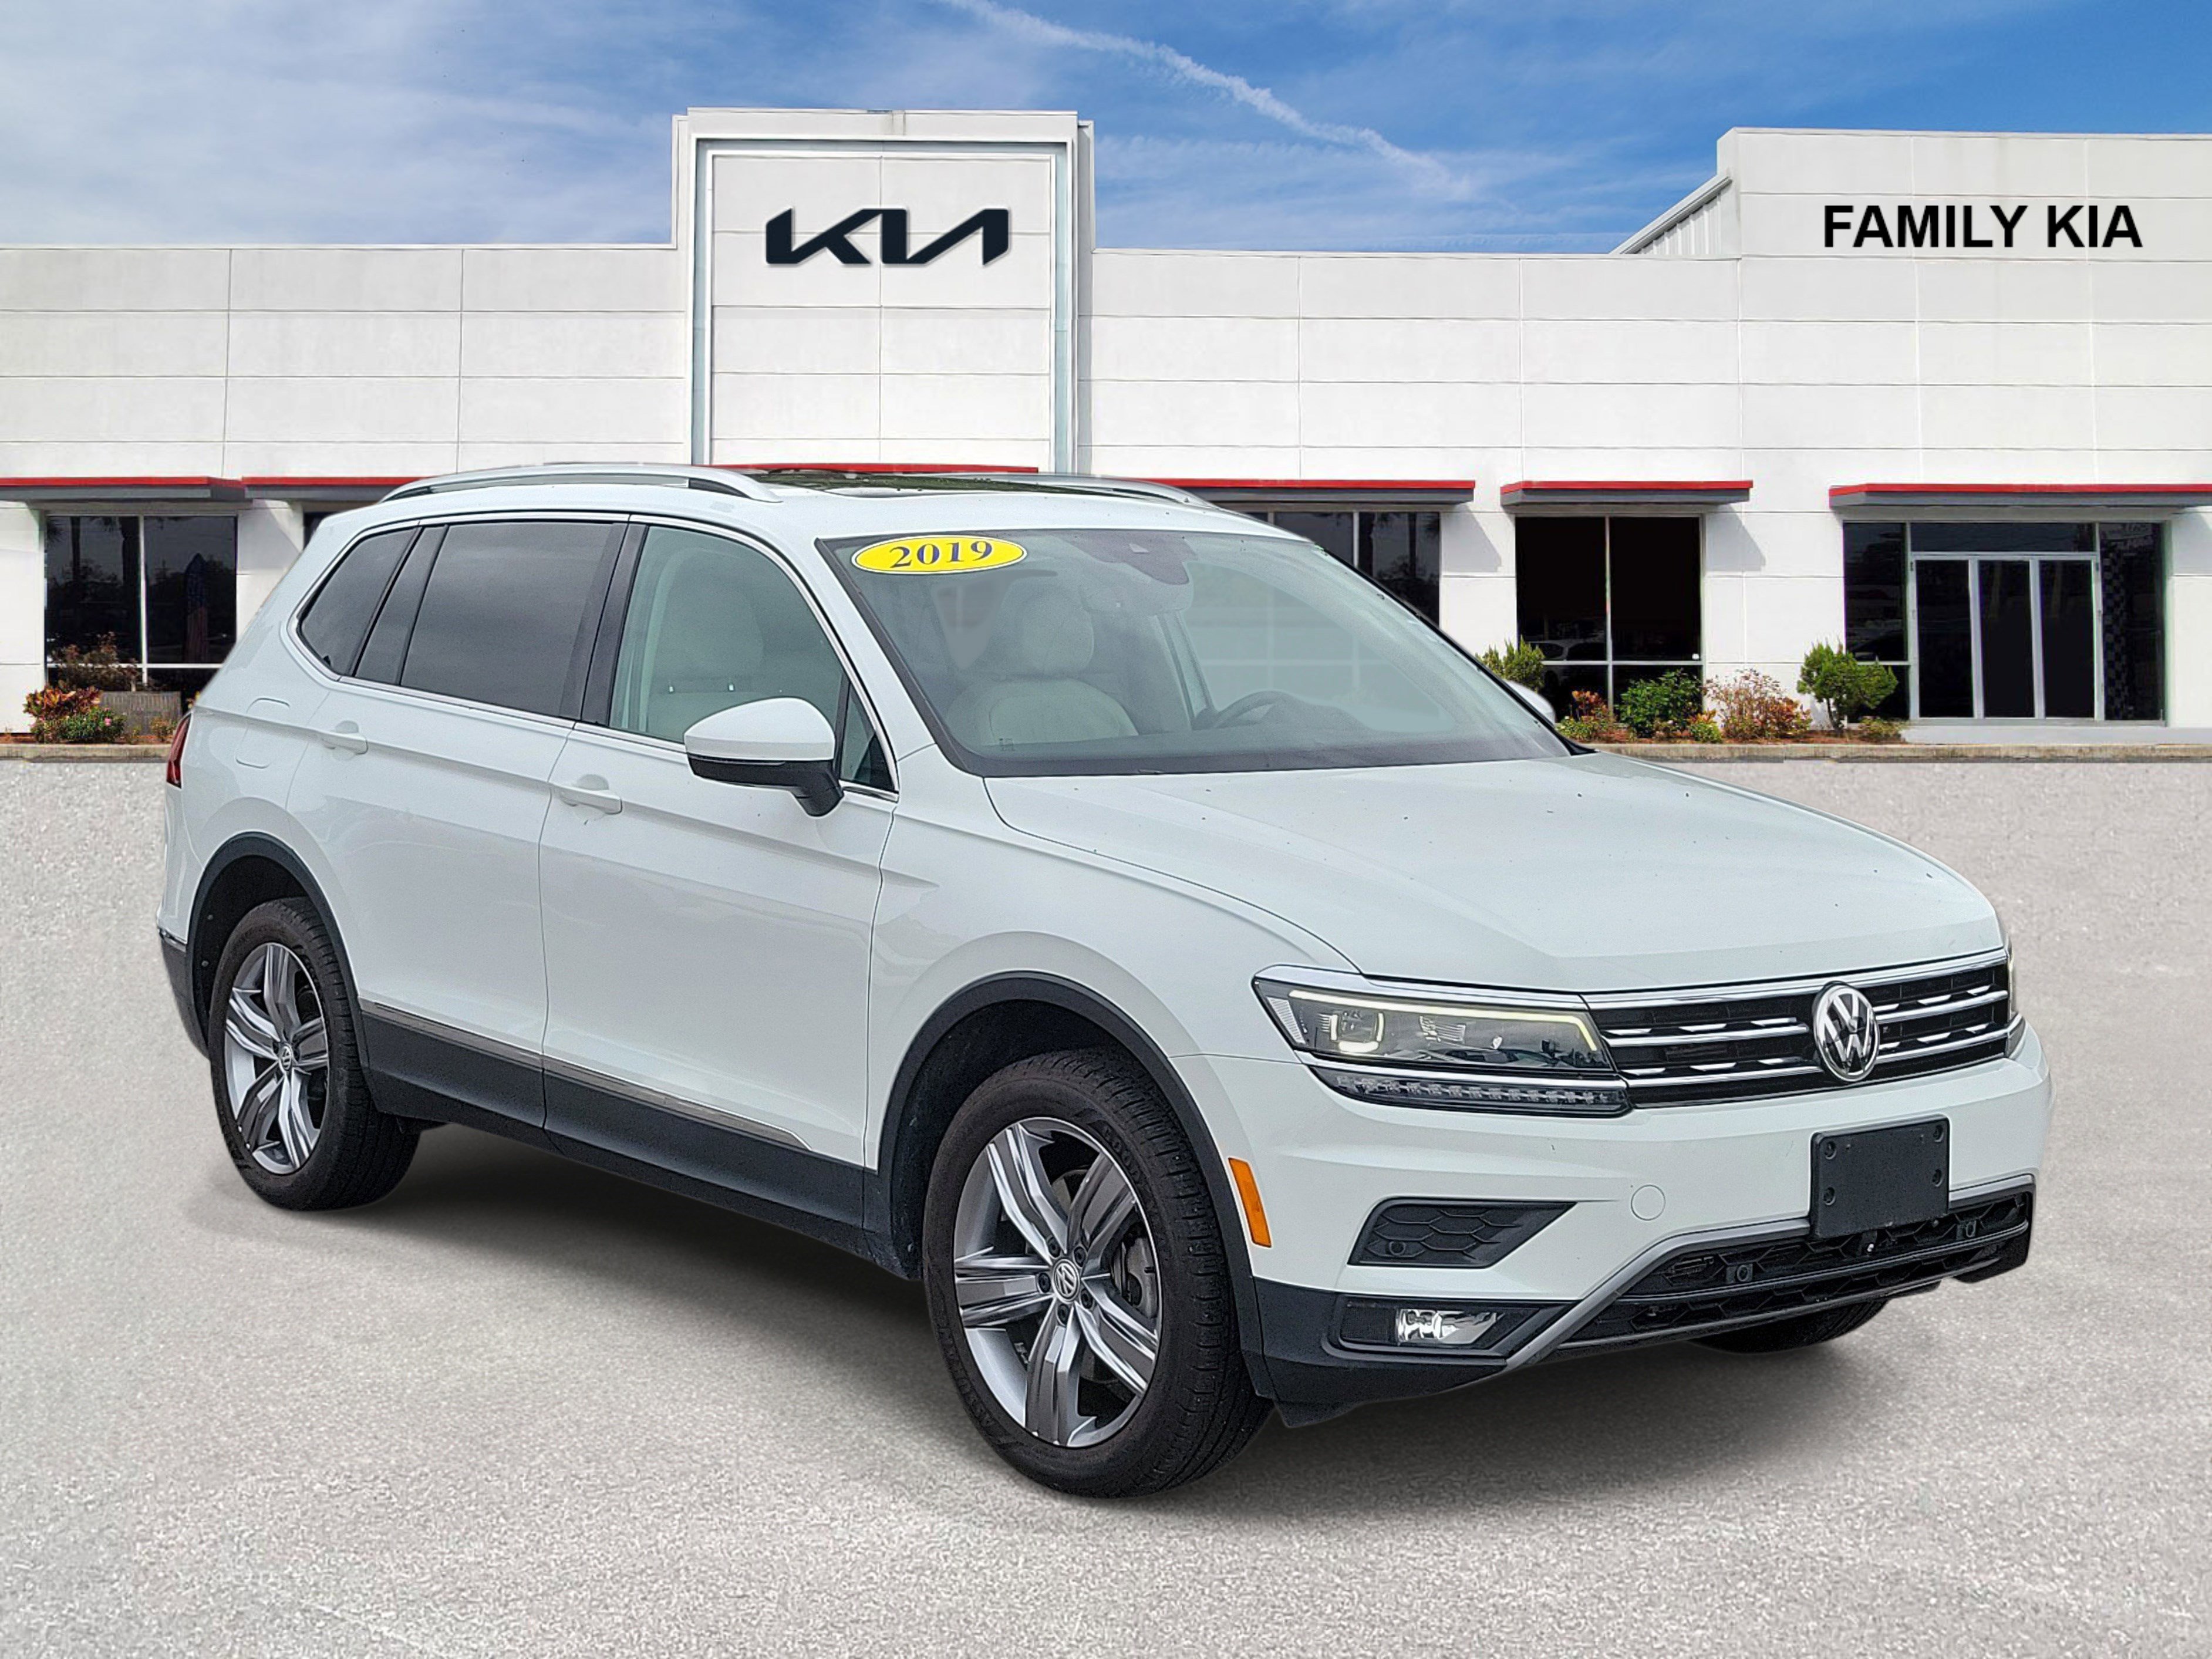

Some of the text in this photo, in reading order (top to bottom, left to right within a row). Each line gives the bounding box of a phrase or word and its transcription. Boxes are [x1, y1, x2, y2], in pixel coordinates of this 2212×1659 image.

[766, 208, 1009, 265] KIA
[1824, 205, 2143, 248] FAMILY KIA
[889, 541, 993, 568] 2019
